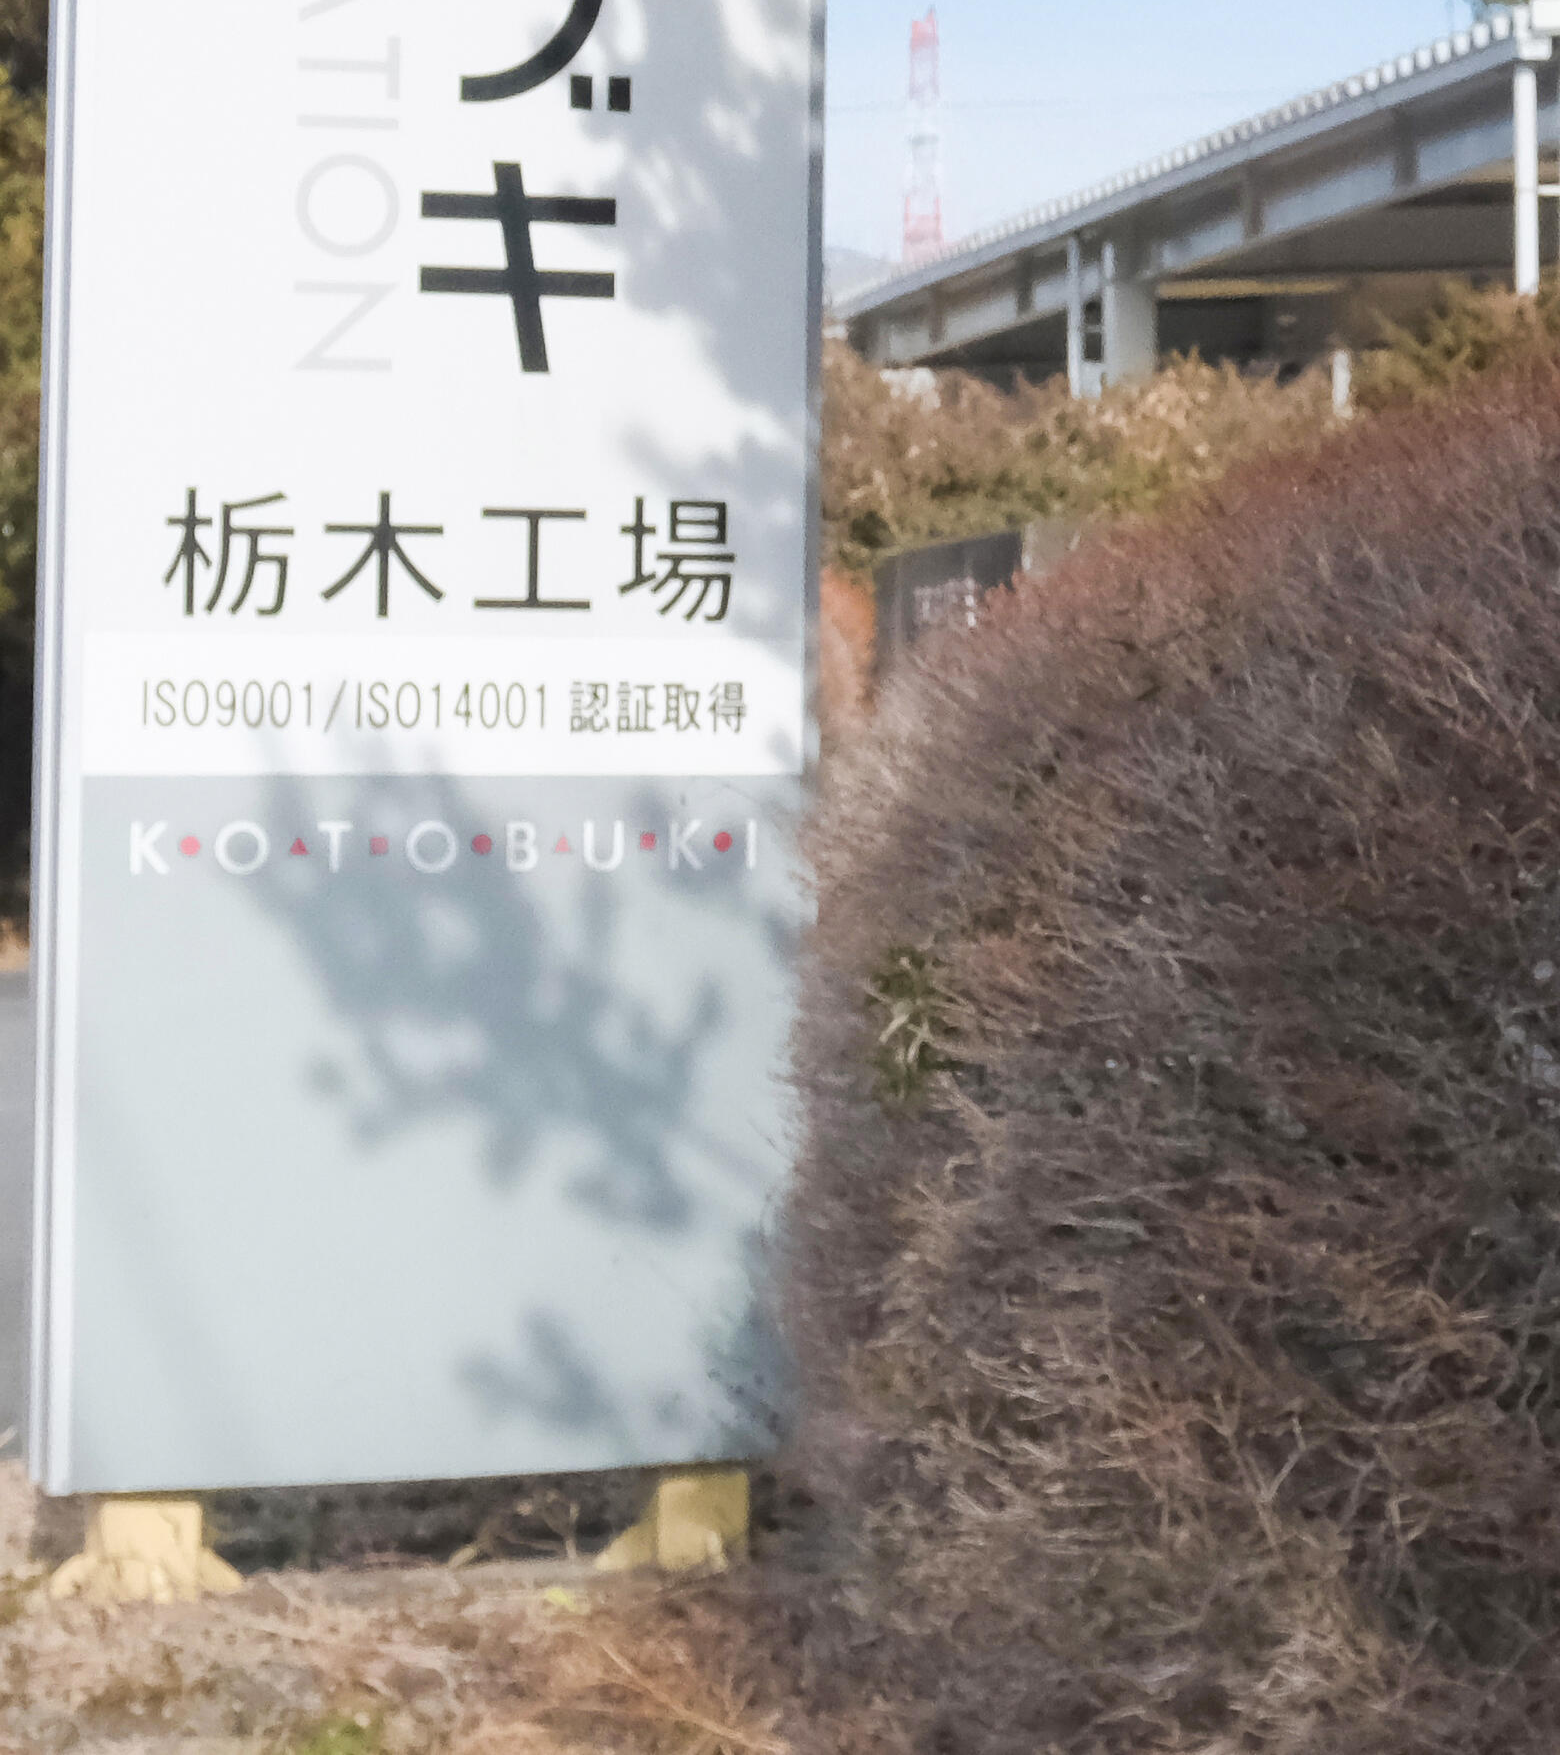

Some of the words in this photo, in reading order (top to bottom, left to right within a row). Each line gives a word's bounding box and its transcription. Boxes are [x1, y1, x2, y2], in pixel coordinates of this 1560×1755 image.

[162, 487, 737, 622] 栃木工場
[142, 679, 547, 733] ISO9001/ISO14001
[569, 680, 749, 734] 認証取得
